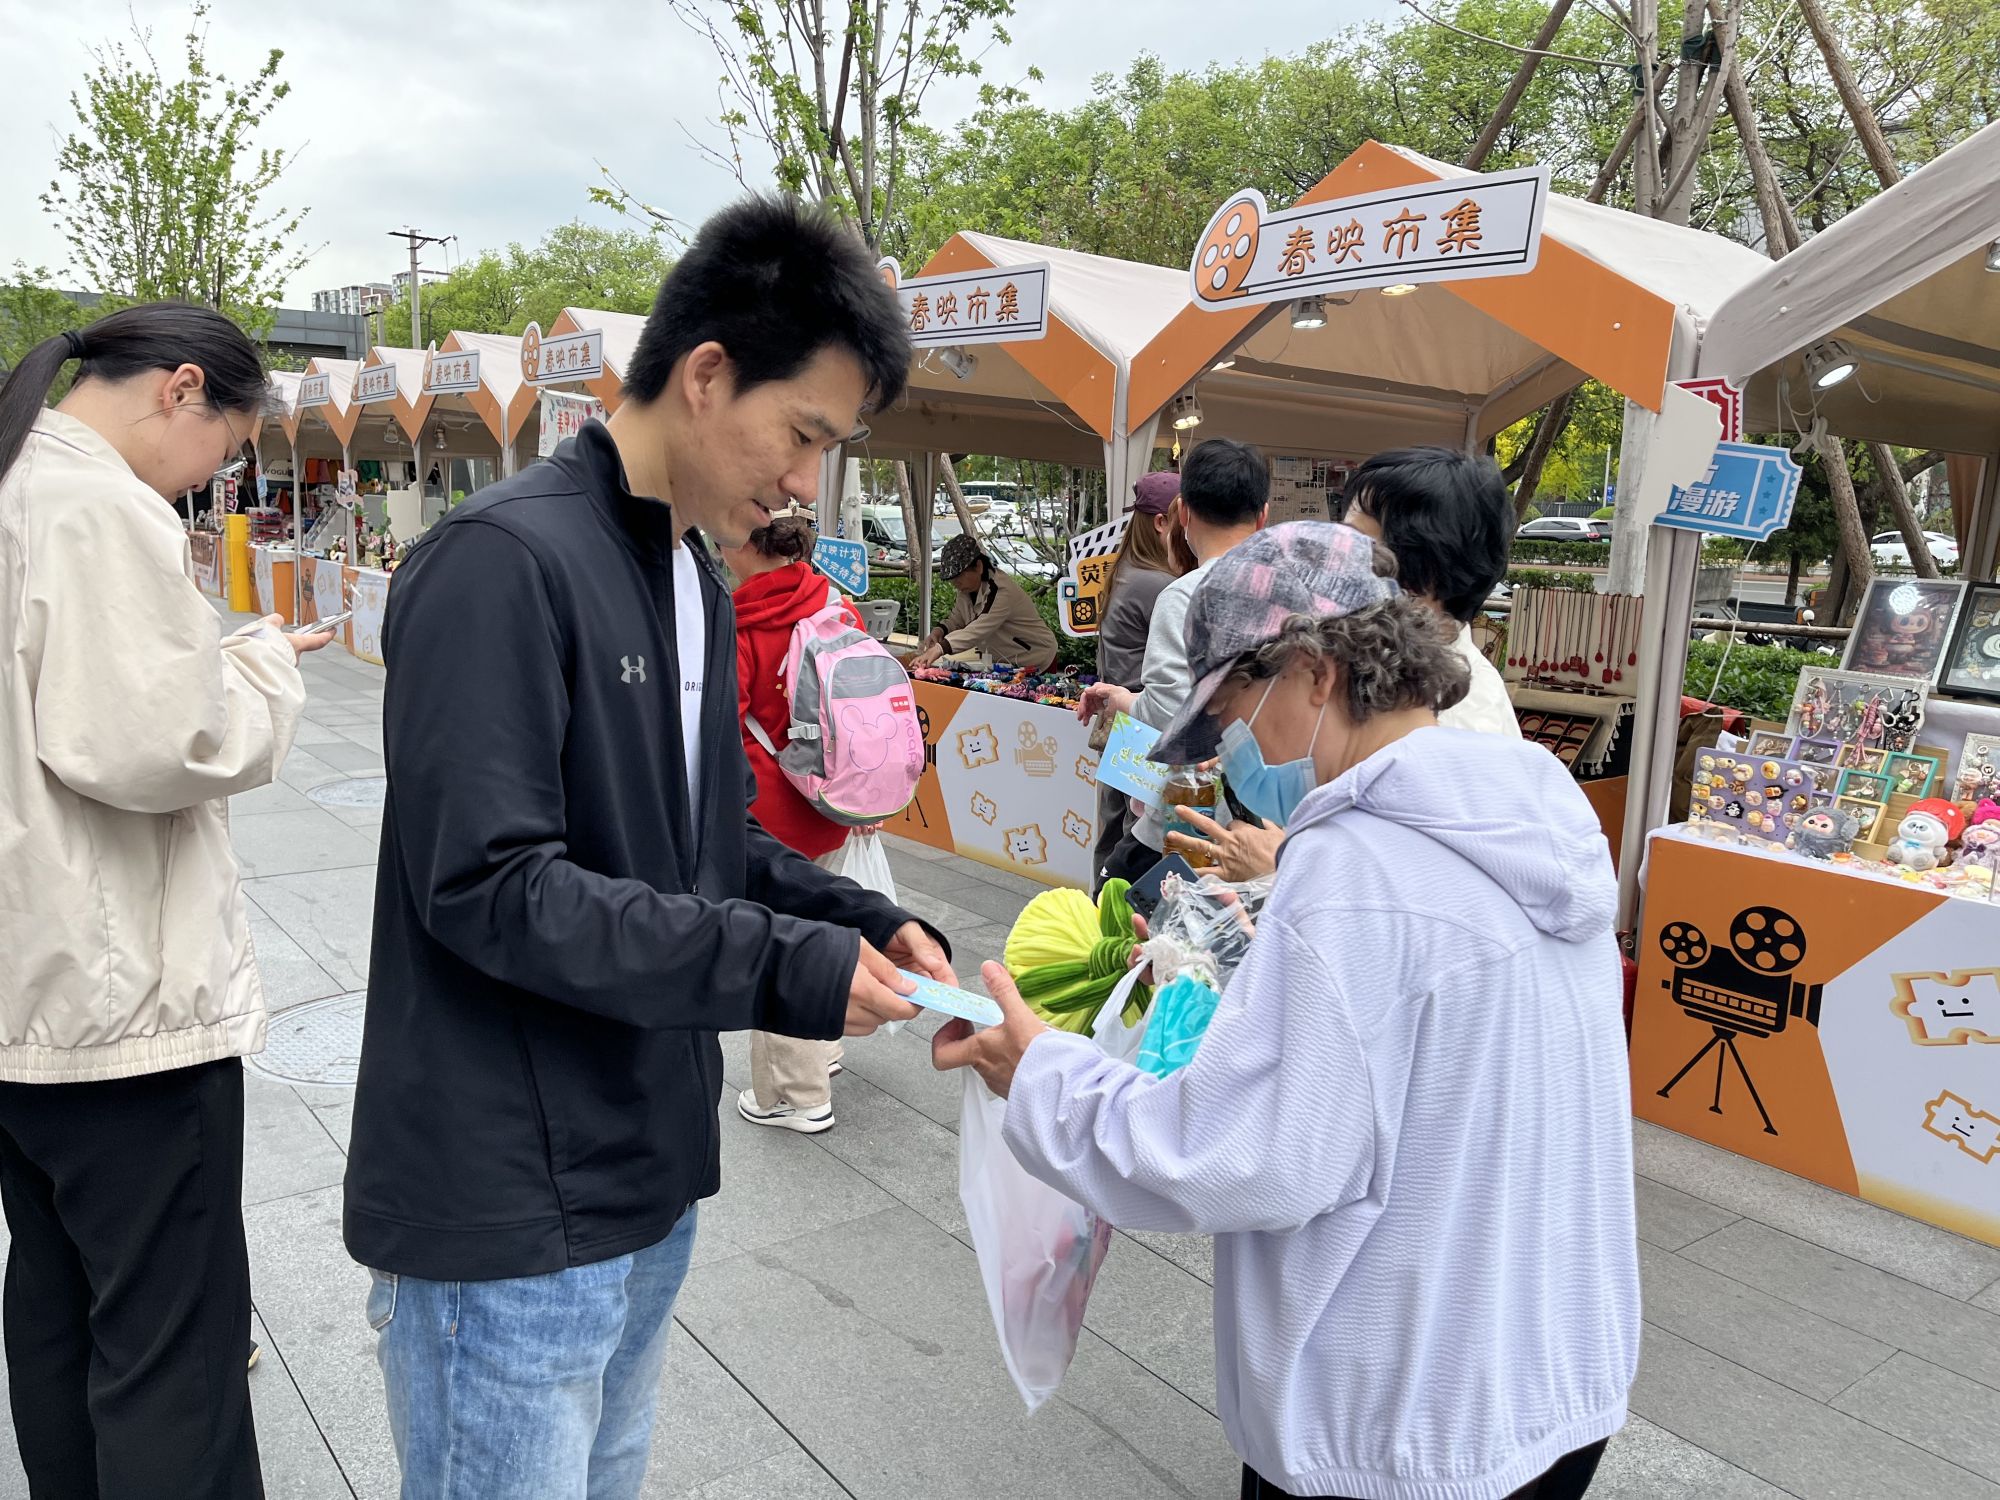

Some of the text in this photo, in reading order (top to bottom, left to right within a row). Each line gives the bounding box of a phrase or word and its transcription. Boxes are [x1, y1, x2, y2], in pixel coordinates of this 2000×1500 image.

[1277, 198, 1483, 276] 春映市集
[910, 281, 1019, 332] 春映市集
[435, 360, 471, 384] 春映市集
[545, 340, 591, 373] 春映市集
[1670, 486, 1741, 518] 漫游
